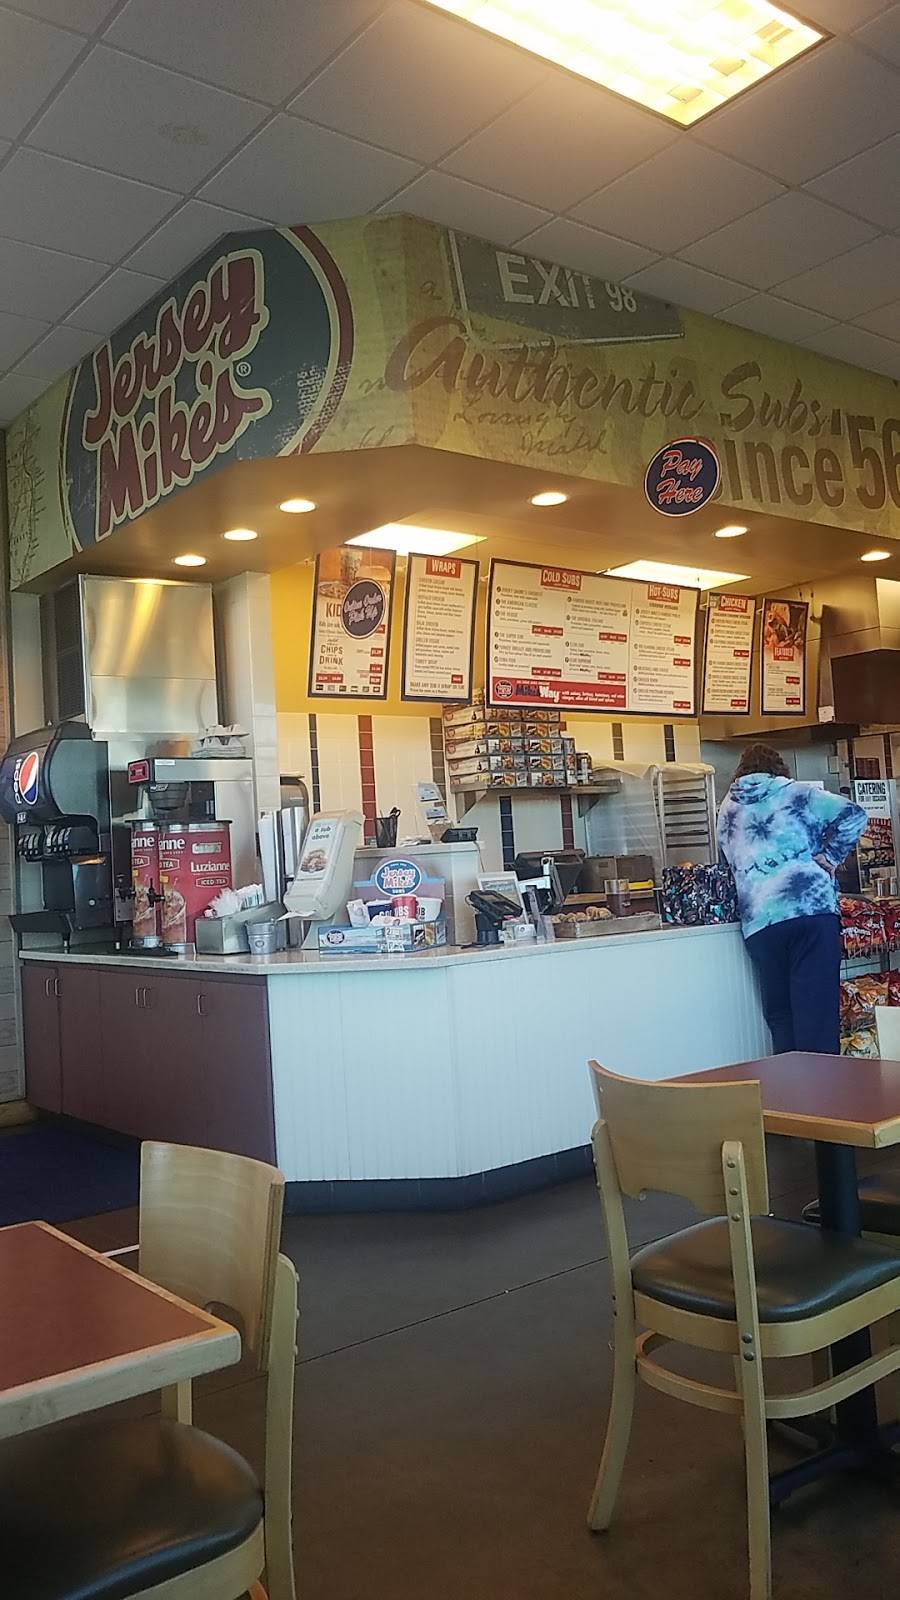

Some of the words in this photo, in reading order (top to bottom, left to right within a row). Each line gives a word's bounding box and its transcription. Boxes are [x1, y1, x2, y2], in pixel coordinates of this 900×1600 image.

[495, 251, 596, 310] EXIT
[84, 250, 267, 448] Jersey
[384, 316, 706, 421] Authentic
[720, 361, 830, 436] Subs
[96, 353, 270, 541] Mike's
[660, 450, 703, 482] Pay
[715, 439, 846, 508] ince
[656, 478, 704, 506] Here
[432, 559, 456, 575] WRAPS
[542, 569, 560, 584] COLD
[561, 572, 580, 588] SUBS
[721, 595, 746, 609] CHICKEN
[321, 645, 344, 655] CHIPS
[319, 656, 344, 667] DRINK
[539, 685, 560, 703] Way
[13, 758, 23, 805] pepsi
[857, 782, 886, 795] CATERING
[381, 867, 416, 879] Jersey
[383, 877, 416, 889] Mike's
